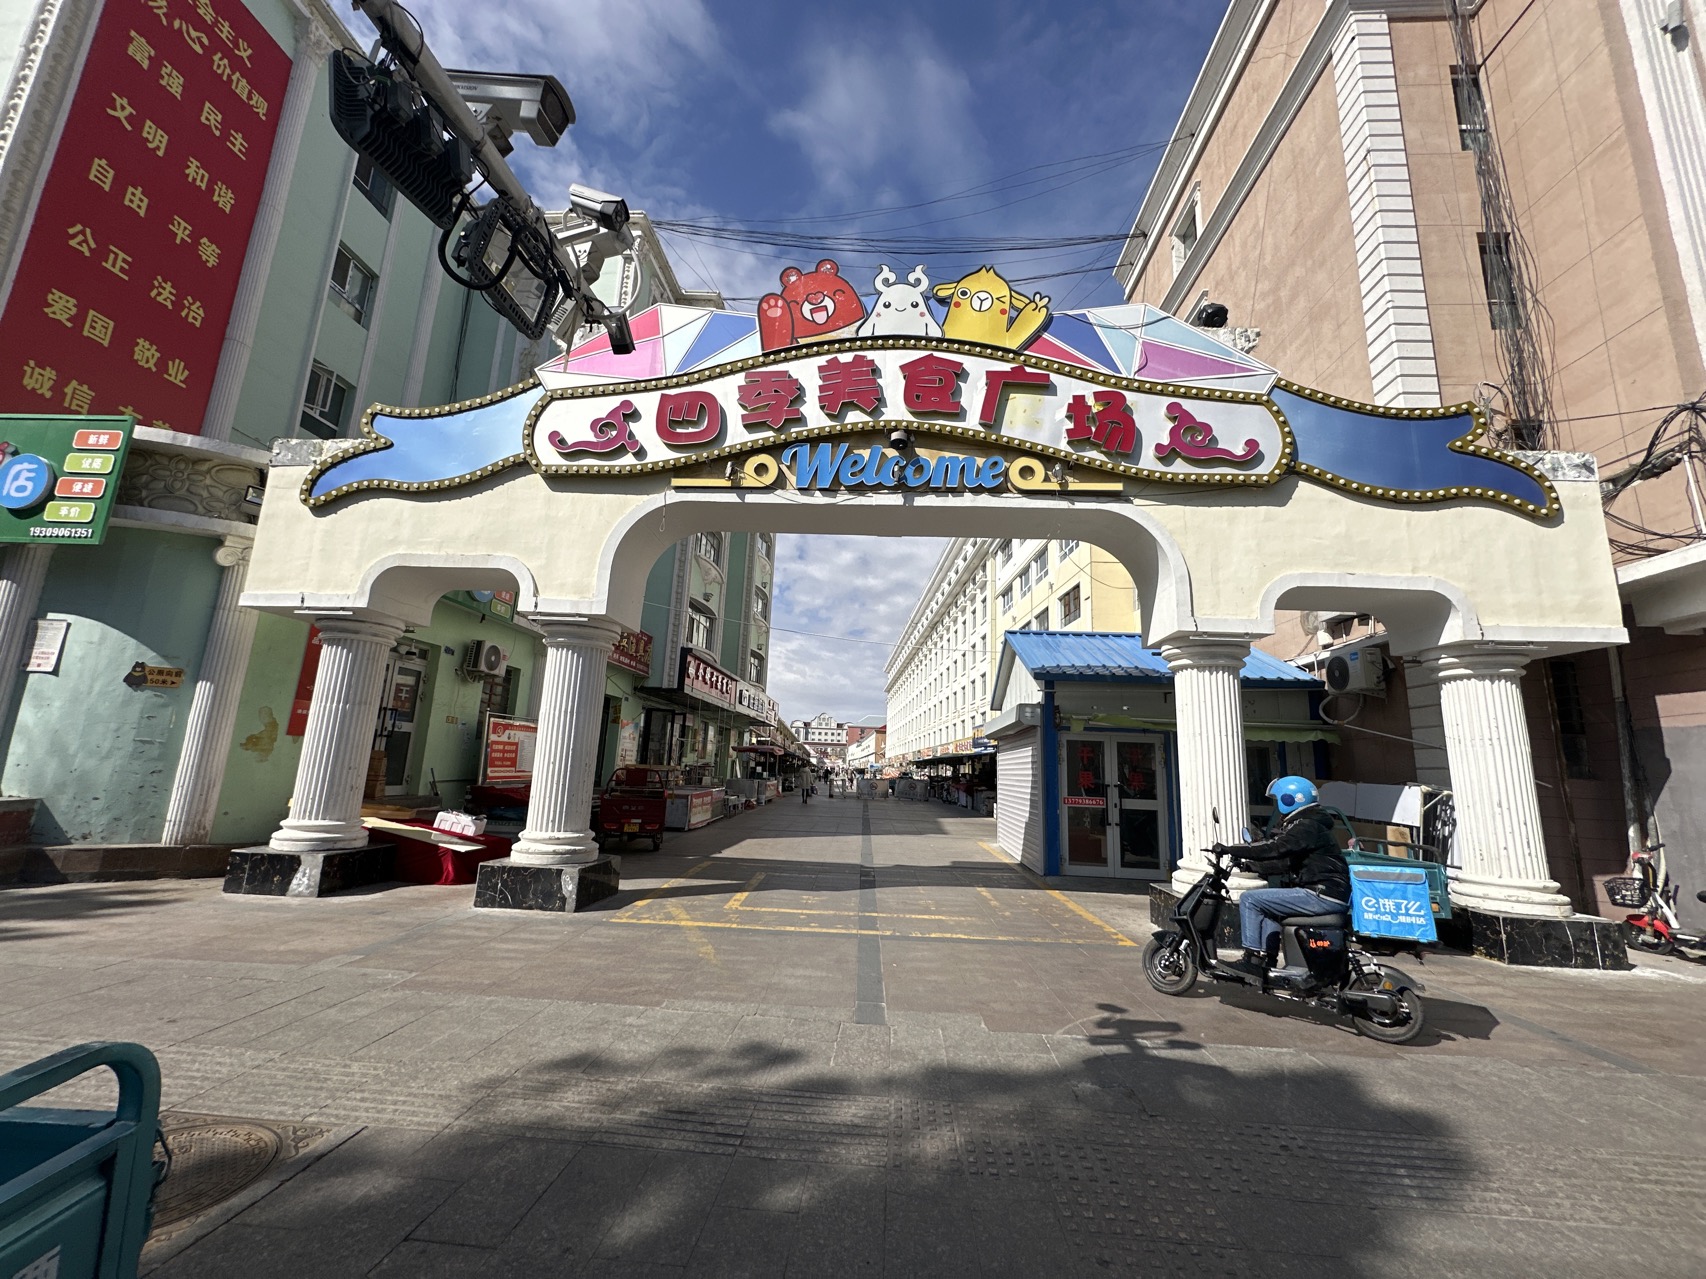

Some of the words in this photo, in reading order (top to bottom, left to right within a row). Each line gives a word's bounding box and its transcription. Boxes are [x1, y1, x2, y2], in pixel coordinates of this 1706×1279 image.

[127, 29, 185, 100] 富强
[200, 100, 249, 161] 民主
[105, 92, 169, 157] 文明
[184, 156, 236, 214] 和谐
[88, 157, 149, 217] 自由
[168, 214, 222, 268] 平等
[66, 223, 132, 281] 公正
[149, 275, 205, 328] 法治
[22, 359, 96, 415] 诚信
[43, 288, 115, 347] 爱国
[133, 337, 190, 389] 敬业
[655, 353, 1137, 455] 四季美食广场
[2, 461, 39, 498] 店
[781, 442, 1005, 490] Welcome
[29, 526, 93, 538] 19309061351
